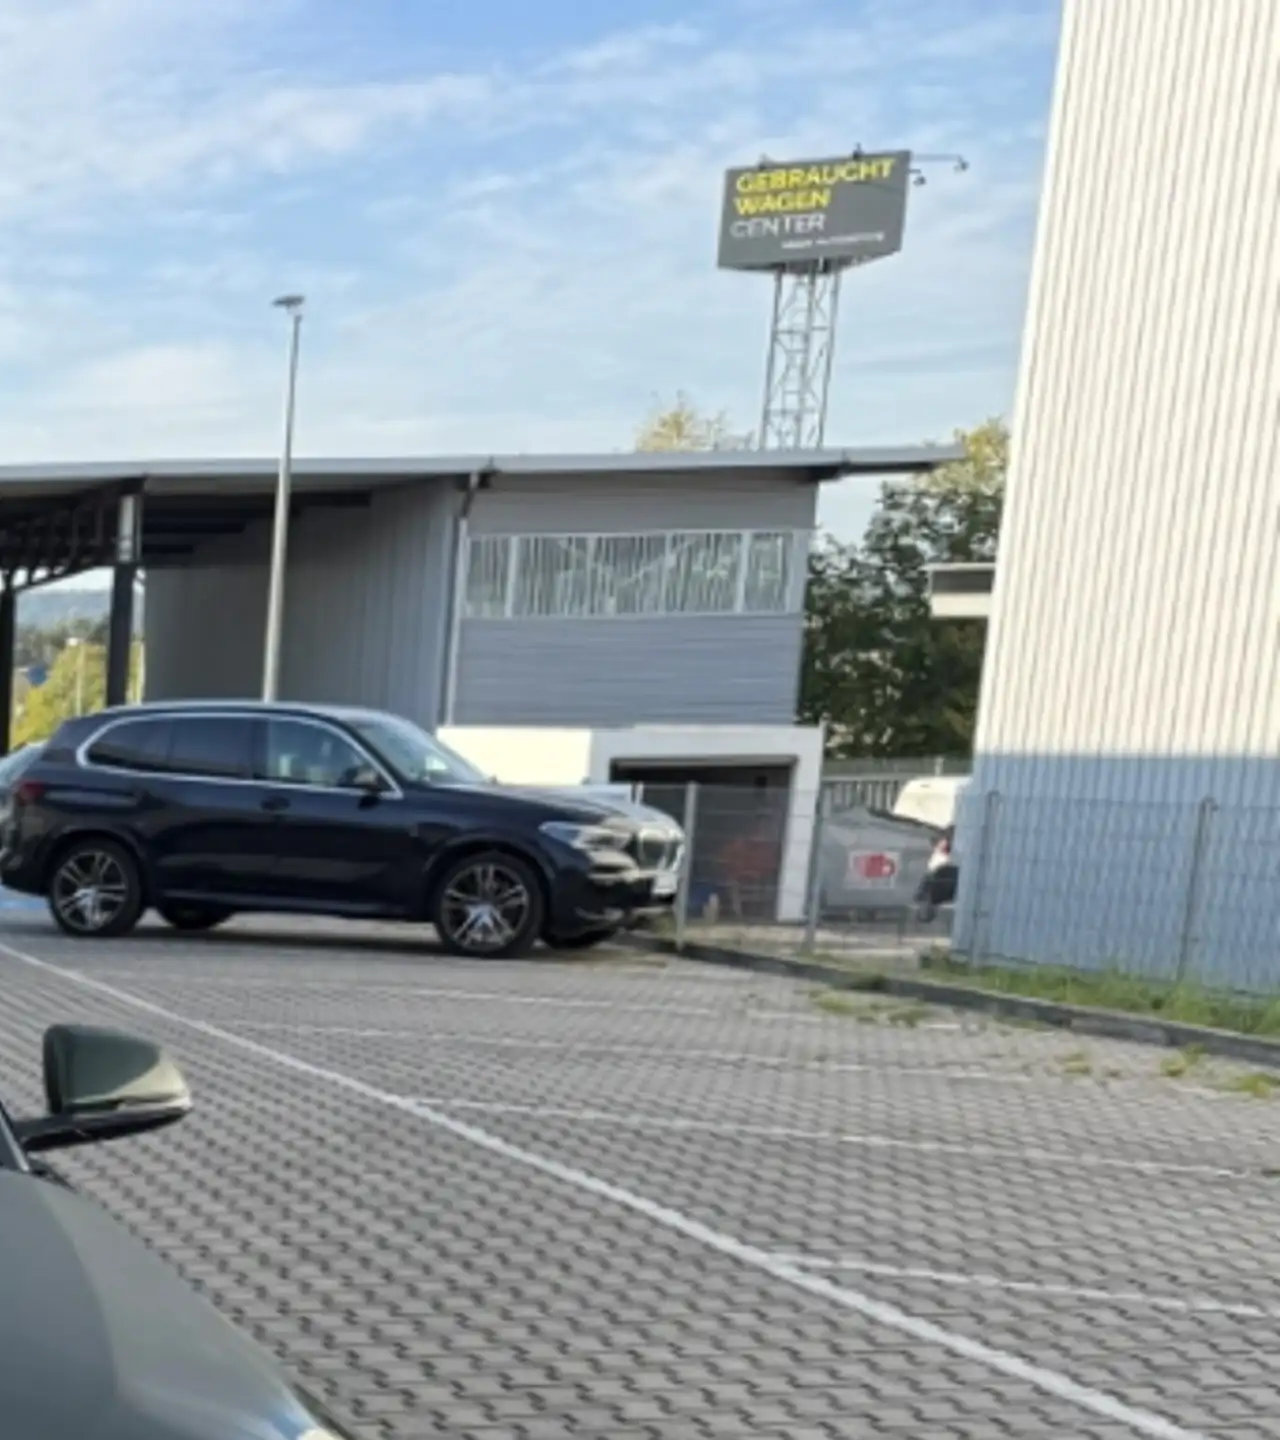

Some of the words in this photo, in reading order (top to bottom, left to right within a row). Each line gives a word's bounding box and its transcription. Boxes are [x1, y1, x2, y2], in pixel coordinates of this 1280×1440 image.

[736, 158, 897, 193] GEBRAUCHT
[733, 188, 832, 216] WAGEN
[730, 212, 827, 239] CENTER
